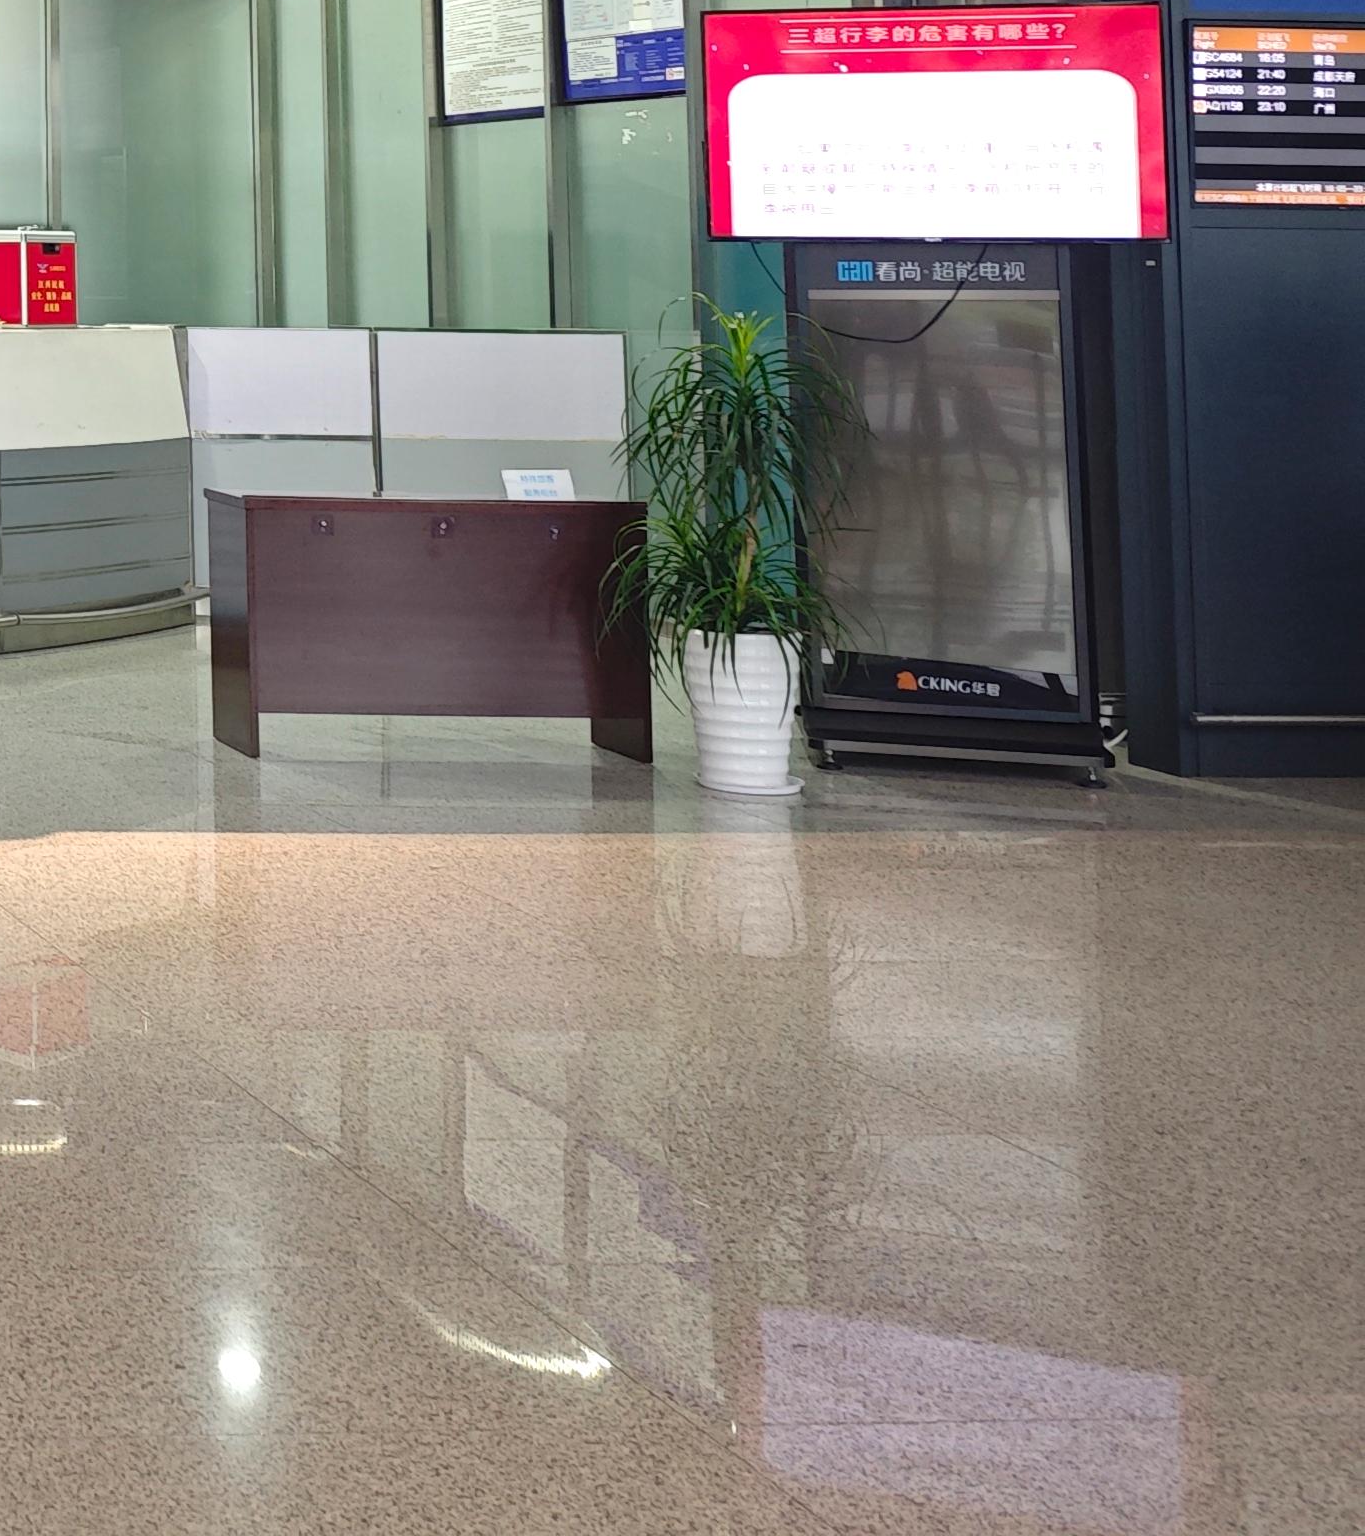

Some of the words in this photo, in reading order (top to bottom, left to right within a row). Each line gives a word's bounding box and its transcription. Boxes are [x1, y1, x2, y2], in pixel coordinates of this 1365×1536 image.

[788, 23, 1067, 44] 三超行李的危害有哪些？
